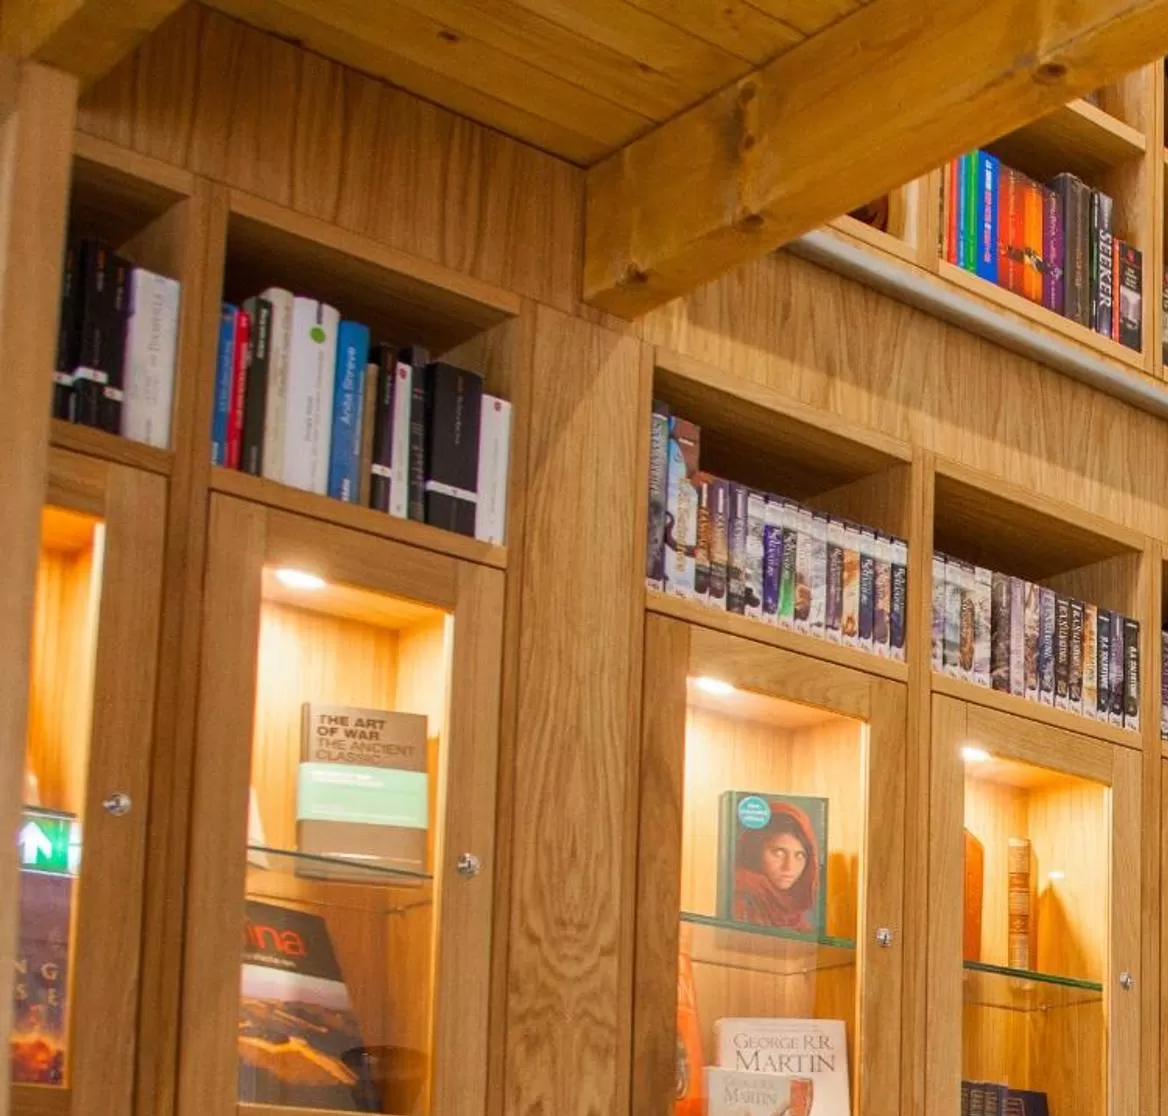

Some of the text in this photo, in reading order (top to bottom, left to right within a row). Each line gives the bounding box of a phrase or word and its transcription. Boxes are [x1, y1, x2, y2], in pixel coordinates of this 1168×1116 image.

[1099, 229, 1112, 308] SEEKER
[339, 393, 353, 426] Anita
[319, 714, 387, 730] THE ART
[317, 726, 380, 741] OF WAR
[315, 750, 383, 763] CLASSIC
[317, 738, 416, 757] THE ANCIENT
[733, 1032, 799, 1049] GEORGE
[736, 1050, 836, 1073] MARTIN
